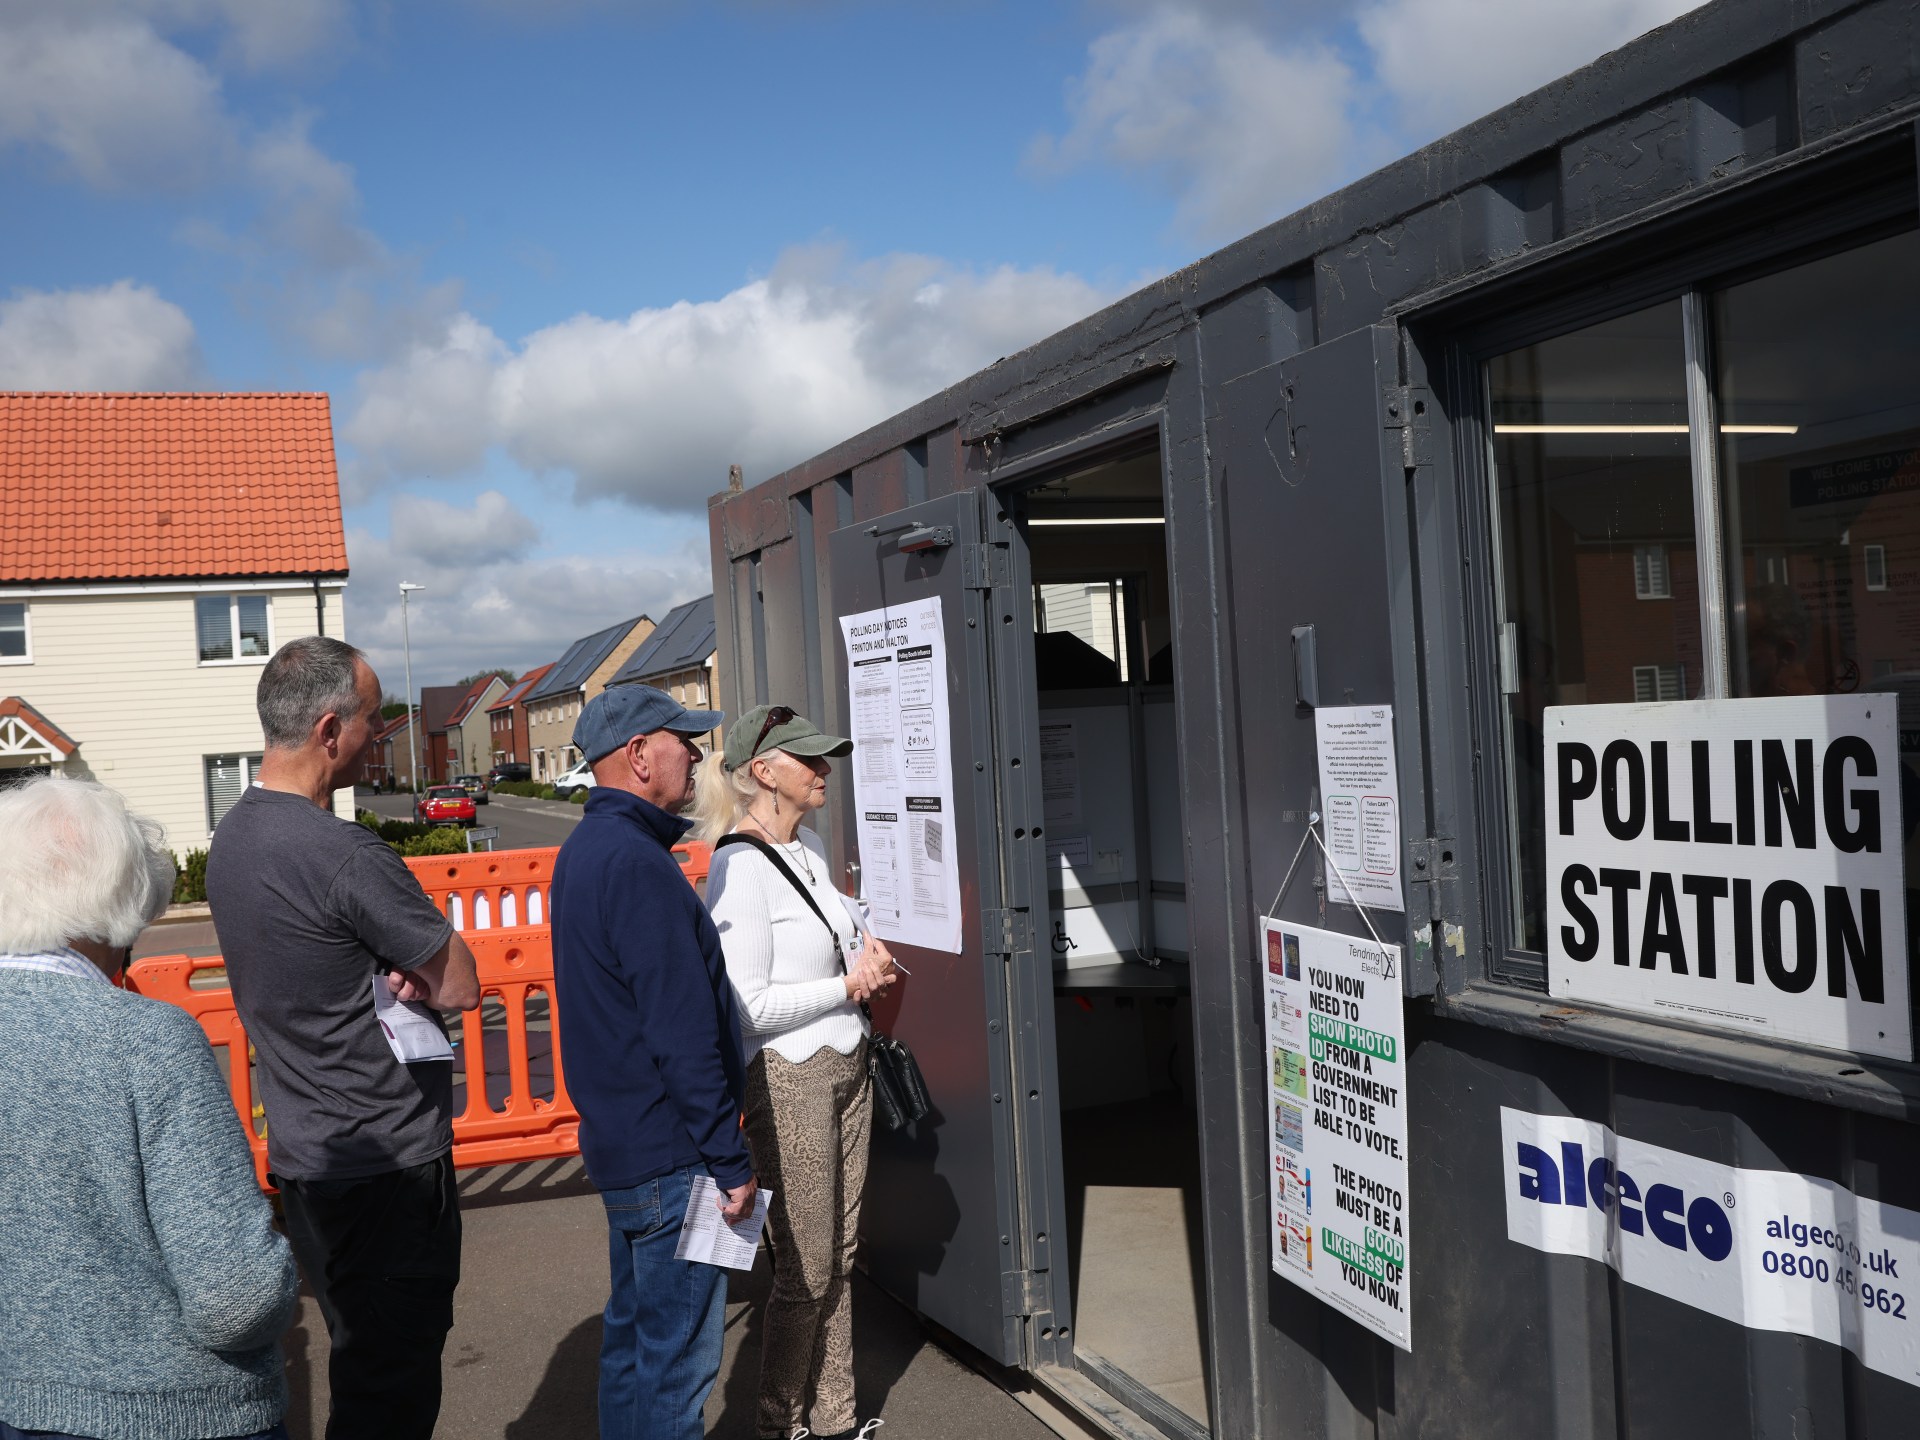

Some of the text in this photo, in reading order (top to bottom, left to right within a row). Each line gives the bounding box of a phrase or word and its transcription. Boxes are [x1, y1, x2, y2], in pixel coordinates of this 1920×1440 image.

[1811, 459, 1871, 480] WELCOME
[1874, 456, 1892, 469] TO
[1817, 472, 1920, 499] POLLING STATIO
[851, 617, 907, 637] POLLING DAY NOTICES
[852, 635, 909, 653] FRINTON AND WALTON
[1557, 735, 1882, 853] POLLING
[1349, 944, 1380, 965] Tendring
[1560, 863, 1885, 1004] STATION
[1308, 966, 1364, 1000] YOU NOW
[1309, 990, 1339, 1016] NEED
[1343, 1000, 1359, 1022] TO
[1310, 1014, 1393, 1057] SHOW PHOTO
[1311, 1038, 1323, 1058] ID
[1326, 1042, 1360, 1072] FROM
[1364, 1055, 1372, 1075] A
[1312, 1061, 1398, 1108] GOVERNMENT
[1313, 1083, 1375, 1125] LIST TO BE
[1314, 1107, 1343, 1136] ABLE
[1346, 1118, 1362, 1144] TO
[1365, 1128, 1402, 1161] VOTE.
[1333, 1163, 1355, 1191] THE
[1359, 1174, 1401, 1211] PHOTO
[1336, 1188, 1402, 1237] MUST BE A
[1324, 1229, 1383, 1277] LIKENESS
[1386, 1261, 1403, 1283] OF
[1366, 1228, 1403, 1262] GOOD
[1766, 1214, 1899, 1279] algeco.co.uk
[1341, 1261, 1365, 1291] YOU
[1369, 1280, 1403, 1313] NOW.
[1762, 1249, 1829, 1283] 0800
[1861, 1282, 1907, 1321] 962
